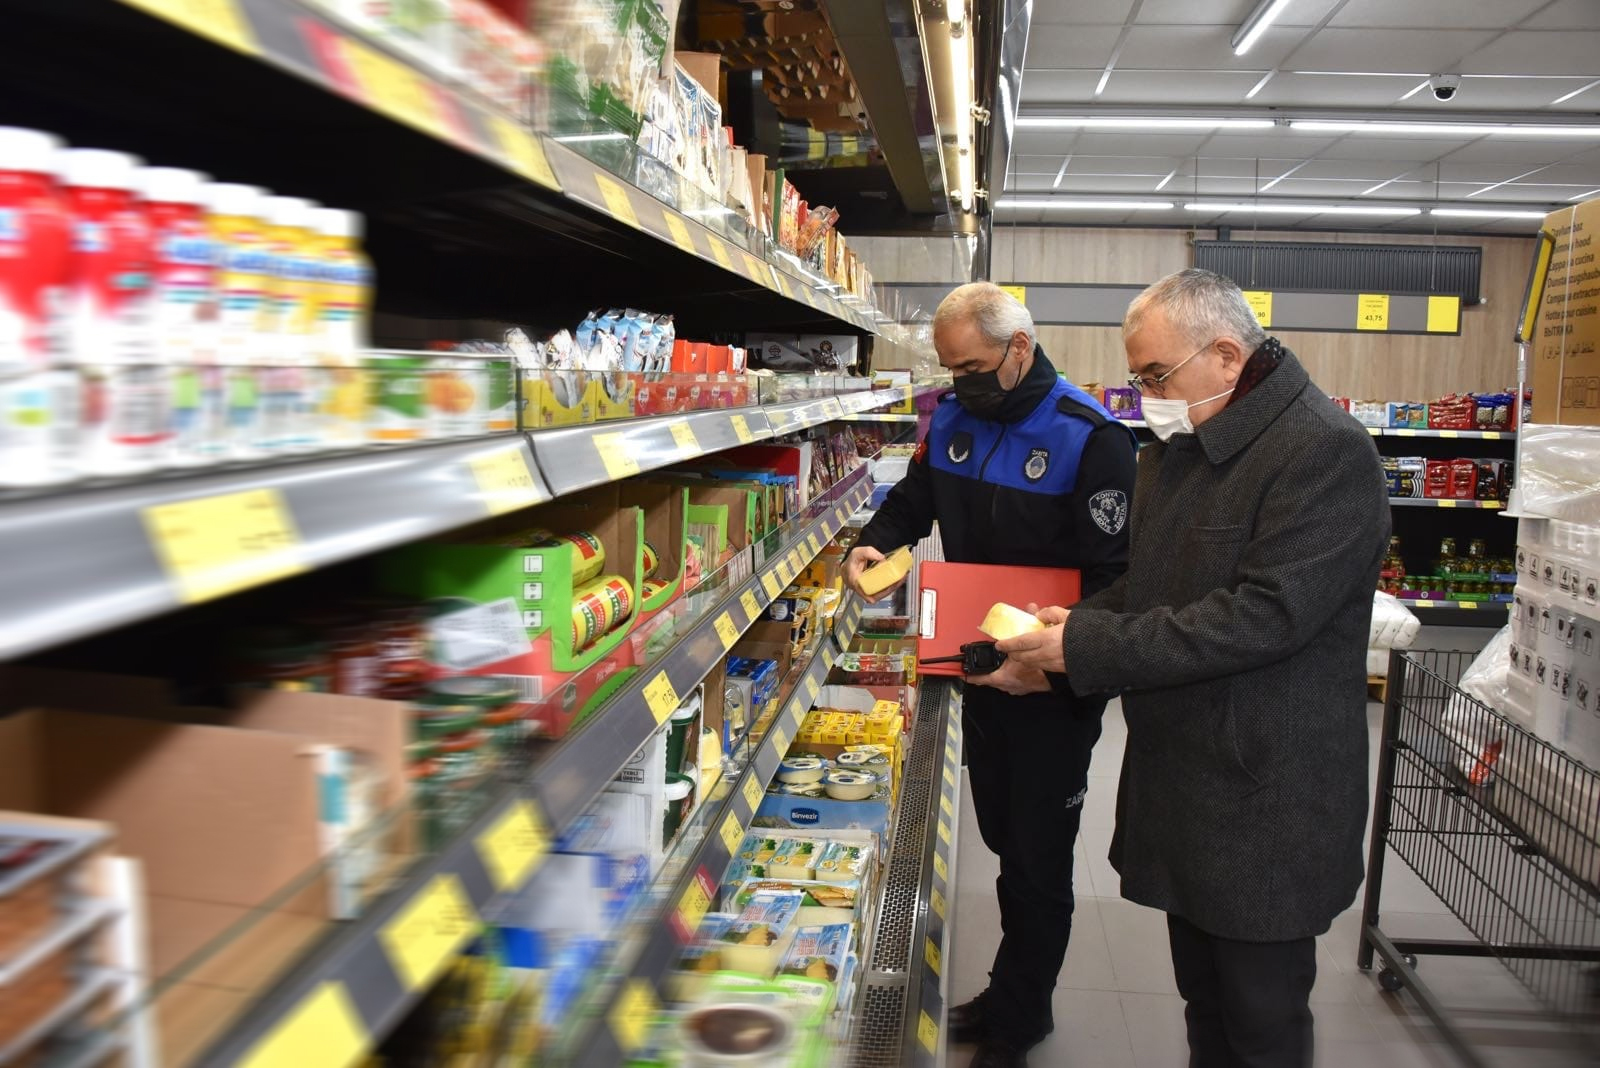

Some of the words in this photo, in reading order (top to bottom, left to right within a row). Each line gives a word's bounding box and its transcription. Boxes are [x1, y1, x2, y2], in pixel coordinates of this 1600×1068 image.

[1575, 252, 1594, 265] cucina
[1095, 492, 1118, 502] KONYA
[791, 811, 818, 820] Binvezir
